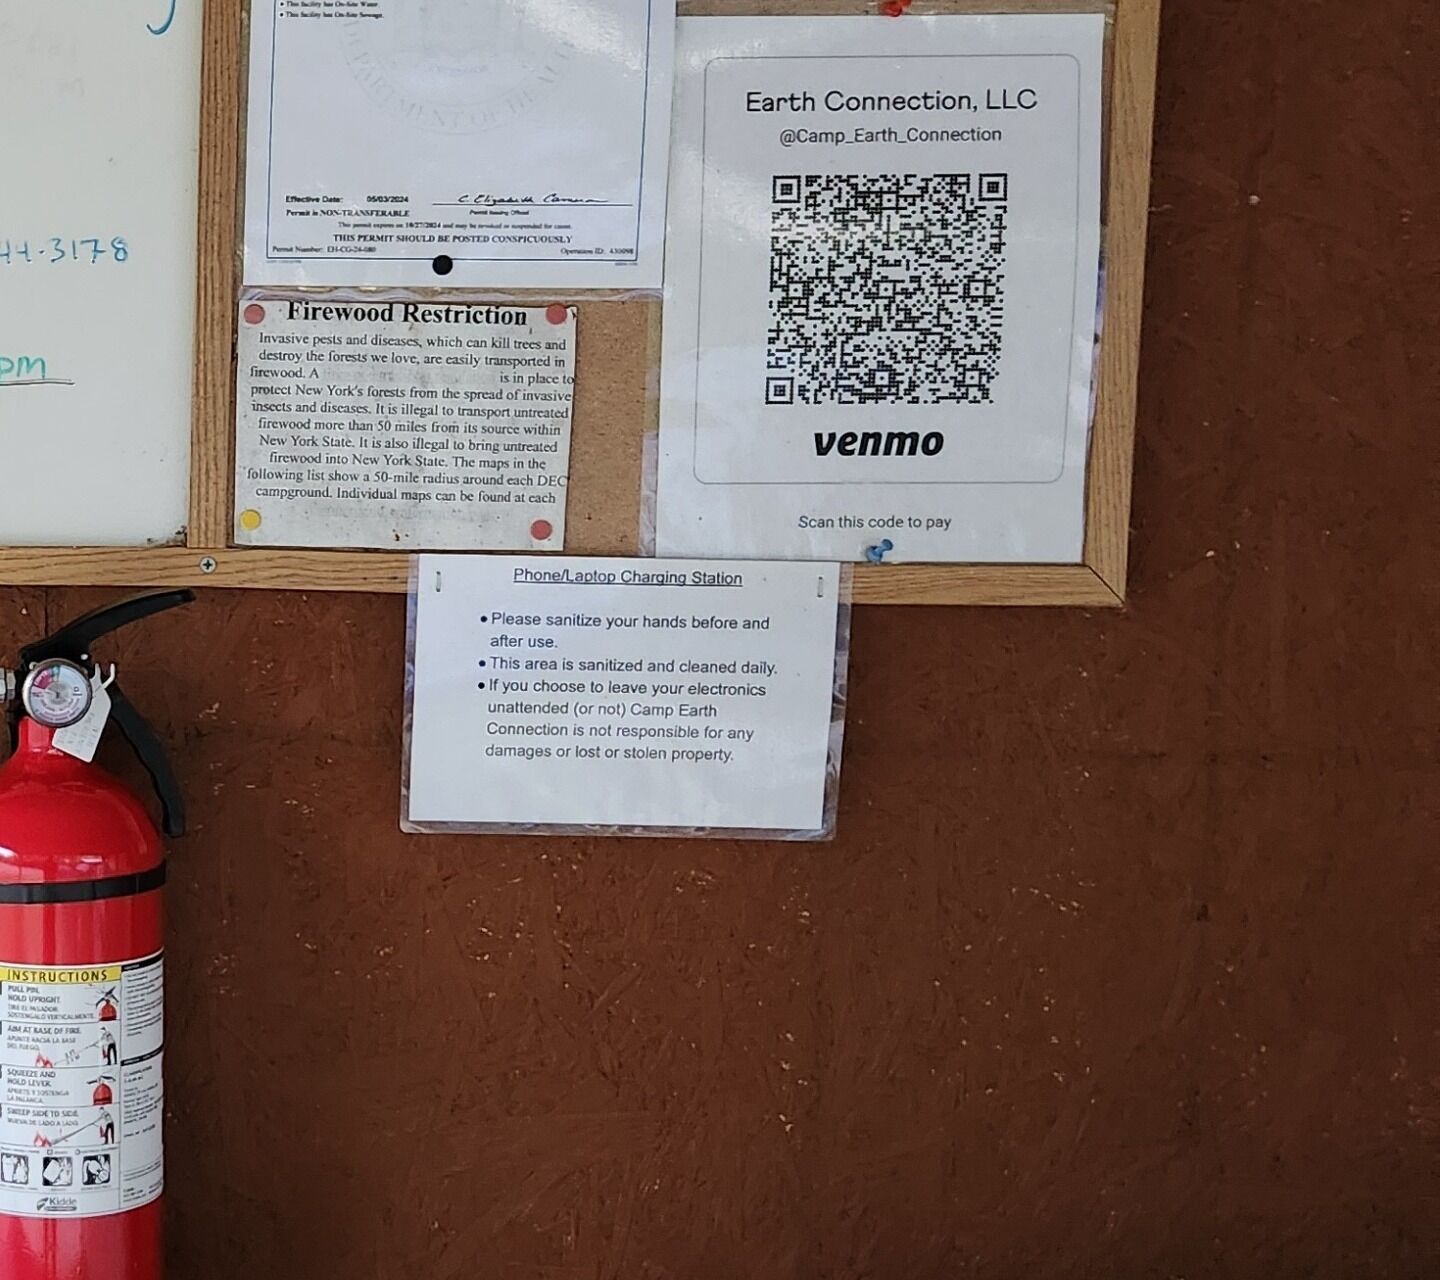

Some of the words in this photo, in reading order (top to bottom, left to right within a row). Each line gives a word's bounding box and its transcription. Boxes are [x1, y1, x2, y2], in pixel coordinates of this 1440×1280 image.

[746, 91, 815, 112] Earth
[824, 90, 979, 113] Connection,
[986, 89, 1038, 111] LLC
[779, 127, 1002, 146] @Camp_Earth_Connection
[319, 209, 410, 217] NON-TRANSFERABLE
[333, 234, 354, 242] THIS
[358, 234, 393, 242] PERMIT
[396, 234, 436, 242] SHOULD
[437, 235, 450, 243] BE
[453, 235, 489, 243] POSTED
[492, 235, 573, 243] CONSPICUOUSLY
[288, 301, 393, 321] Firewood
[402, 304, 527, 325] Restriction
[259, 333, 309, 345] Invasive
[312, 334, 342, 348] pests
[346, 335, 367, 345] and
[371, 335, 422, 348] diseases,
[427, 336, 463, 348] which
[466, 339, 487, 348] can
[491, 337, 509, 349] kill
[513, 339, 542, 350] trees
[545, 339, 566, 350] and
[814, 430, 944, 456] venmo
[798, 515, 835, 529] Scan
[838, 514, 864, 529] this
[867, 514, 904, 528] code
[907, 516, 922, 528] to
[926, 517, 951, 531] pay
[513, 568, 616, 584] Phone/Laptop
[621, 569, 687, 586] Charging
[691, 571, 743, 585] Station
[492, 612, 541, 627] Please
[546, 613, 601, 627] sanitize
[606, 616, 638, 631] your
[642, 615, 687, 629] hands
[691, 616, 738, 630] before
[742, 616, 770, 630] and
[490, 634, 523, 649] after
[528, 637, 558, 649] use.
[490, 657, 520, 671] This
[524, 660, 558, 672] area
[562, 658, 574, 672] is
[578, 658, 643, 672] sanitized
[647, 658, 674, 672] and
[679, 659, 736, 674] cleaned
[741, 660, 777, 677] daily.
[8, 969, 107, 982] INSTRUCTIONS
[49, 1197, 77, 1206] Kidde
